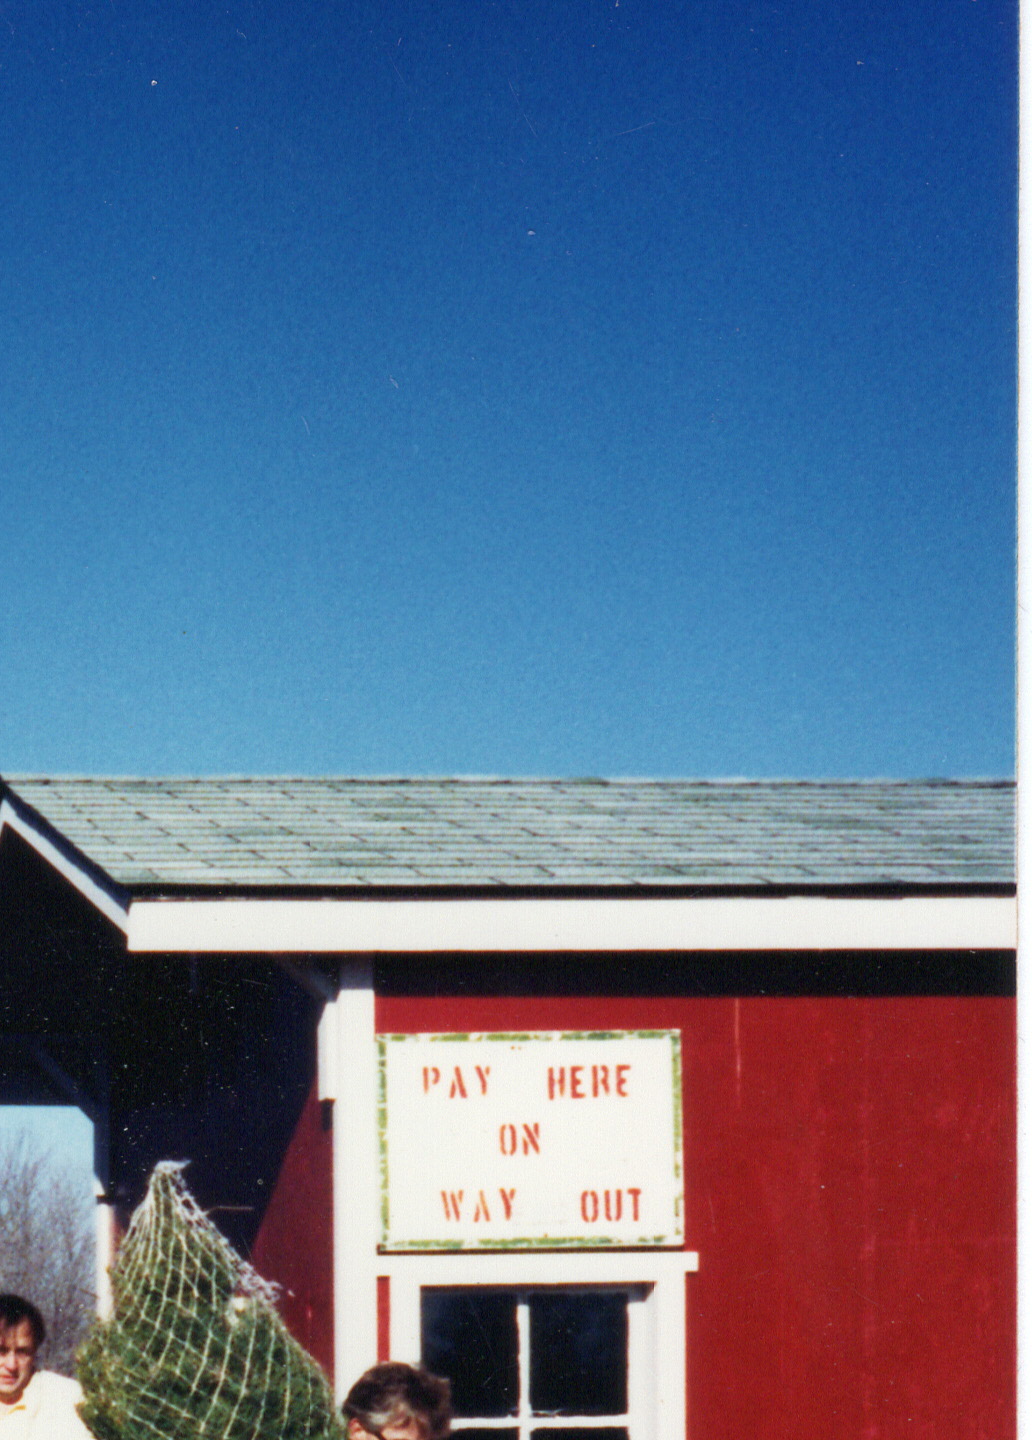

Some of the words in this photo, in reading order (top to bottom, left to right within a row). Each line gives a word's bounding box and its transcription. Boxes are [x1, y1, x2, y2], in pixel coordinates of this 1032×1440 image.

[422, 1065, 491, 1099] PAY
[547, 1064, 632, 1101] HERE
[498, 1122, 541, 1156] ON
[440, 1187, 517, 1223] WAY
[580, 1187, 643, 1223] OUT
